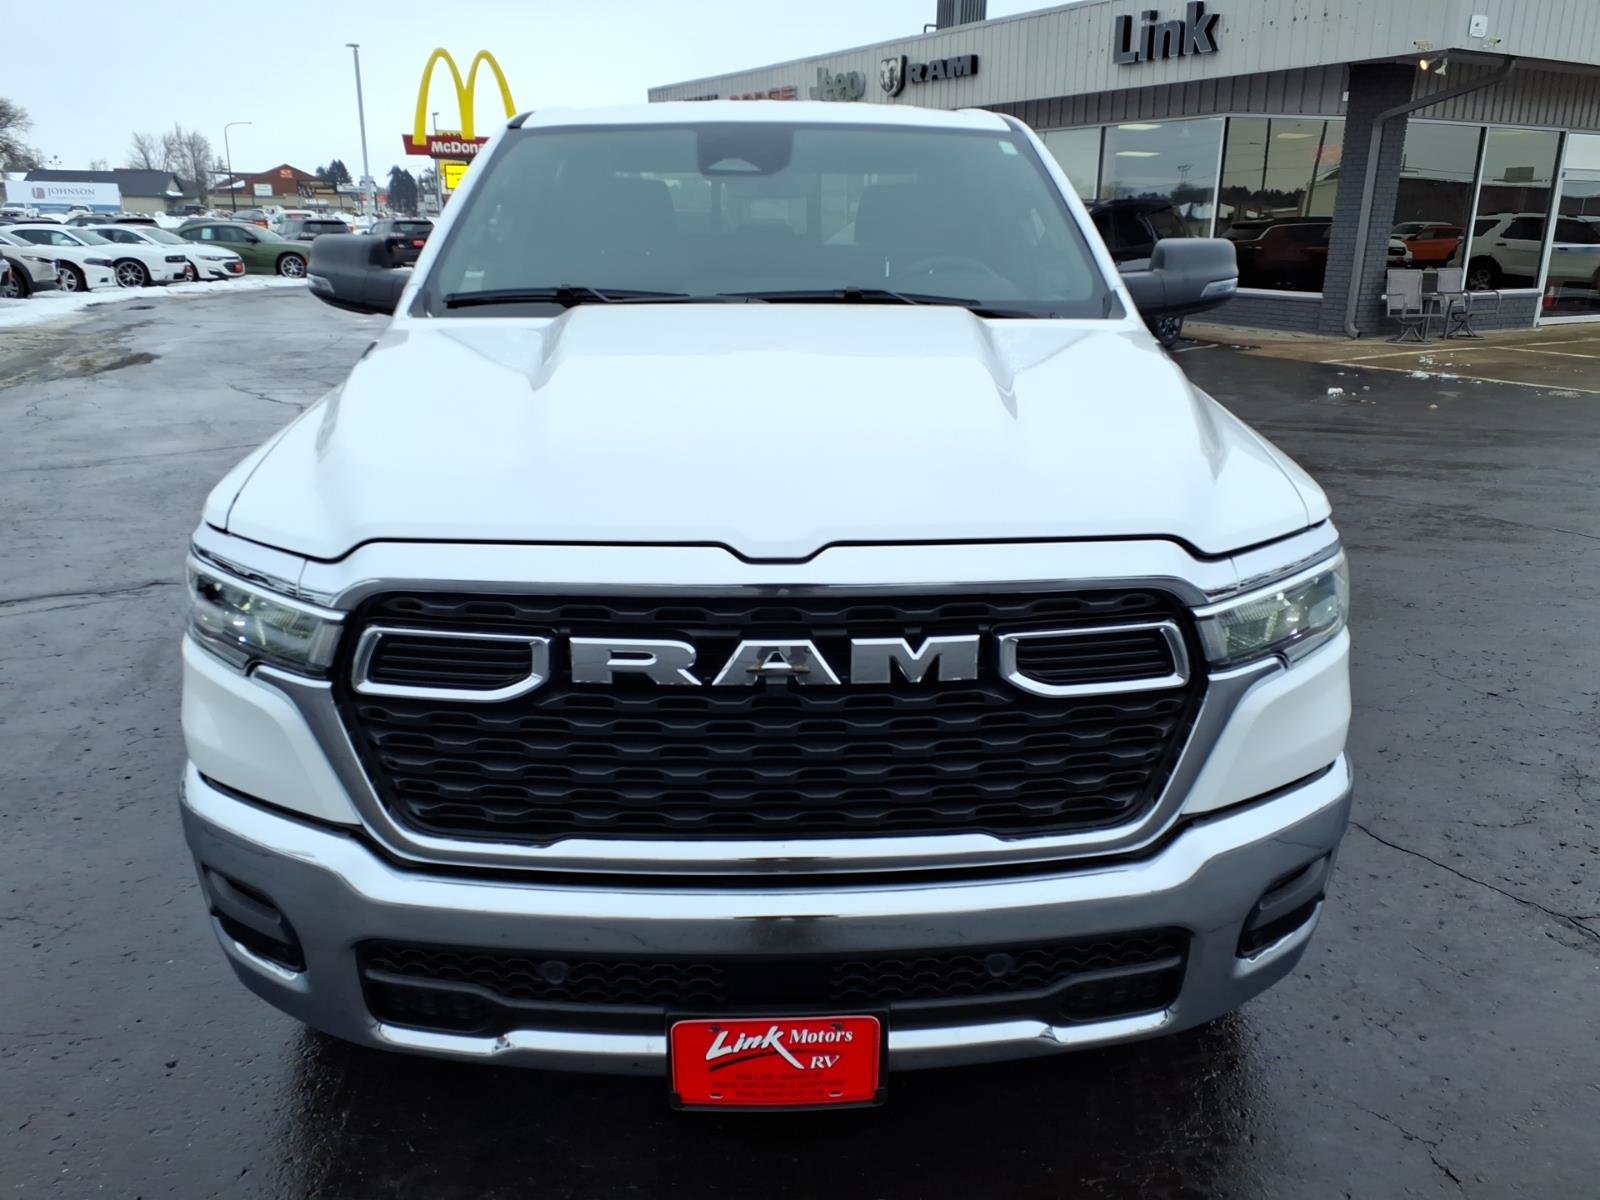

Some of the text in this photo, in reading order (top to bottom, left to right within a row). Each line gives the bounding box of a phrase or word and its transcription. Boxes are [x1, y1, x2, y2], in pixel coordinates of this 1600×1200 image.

[1113, 1, 1220, 65] Link
[809, 67, 866, 101] Jeep
[905, 55, 978, 83] RAM
[48, 187, 95, 196] JOHNSON
[569, 634, 981, 686] RAM
[705, 1025, 853, 1069] Link Motors
[810, 1055, 840, 1069] RV
